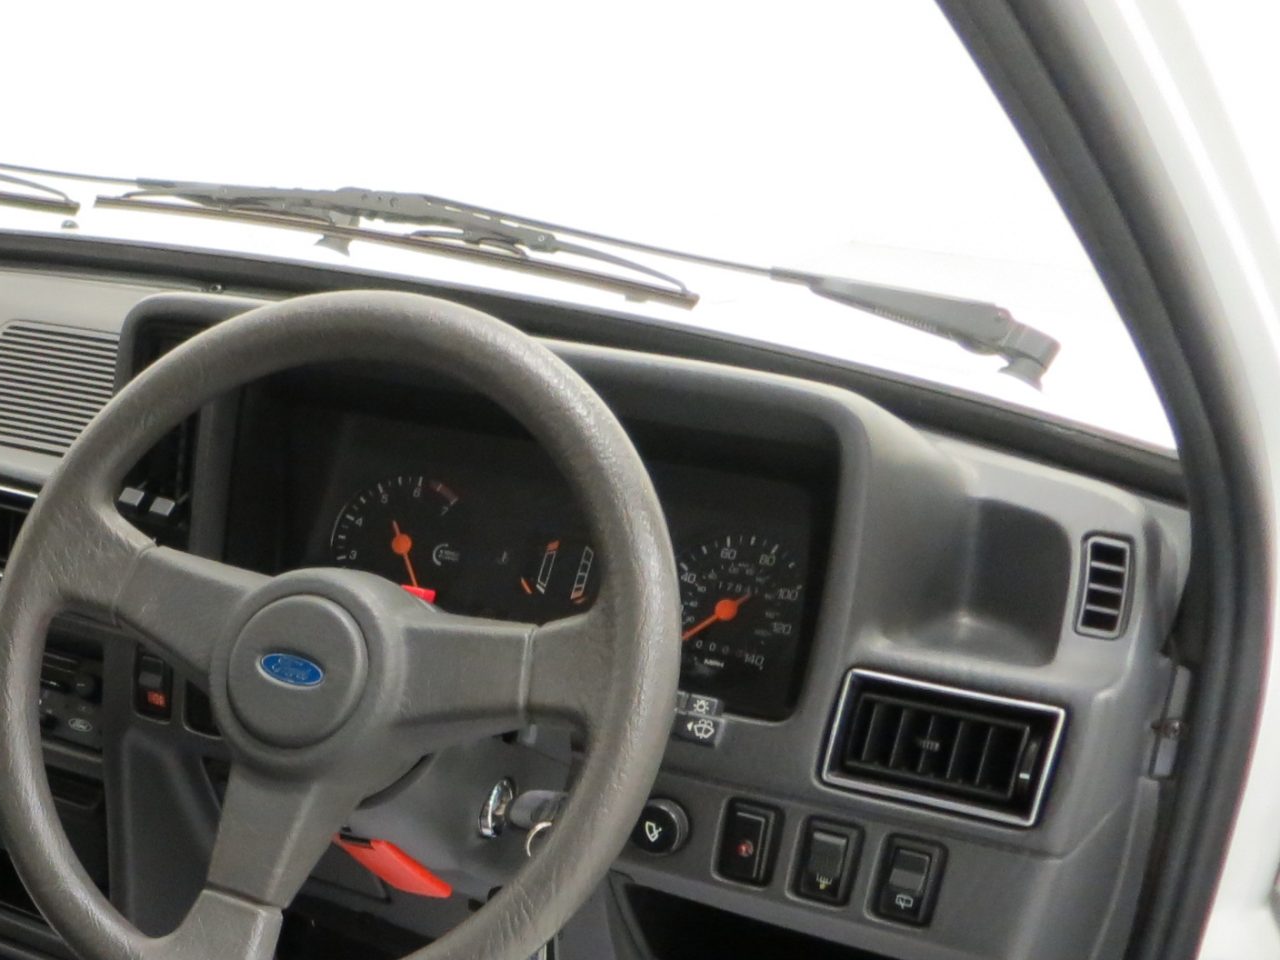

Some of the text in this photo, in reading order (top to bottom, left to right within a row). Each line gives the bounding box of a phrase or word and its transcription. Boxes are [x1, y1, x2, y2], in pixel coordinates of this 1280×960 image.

[355, 516, 363, 527] 4
[348, 549, 358, 560] 3
[720, 548, 737, 560] 60
[759, 554, 776, 566] 80
[680, 572, 697, 584] 40
[777, 587, 798, 601] 100
[772, 622, 792, 635] 120
